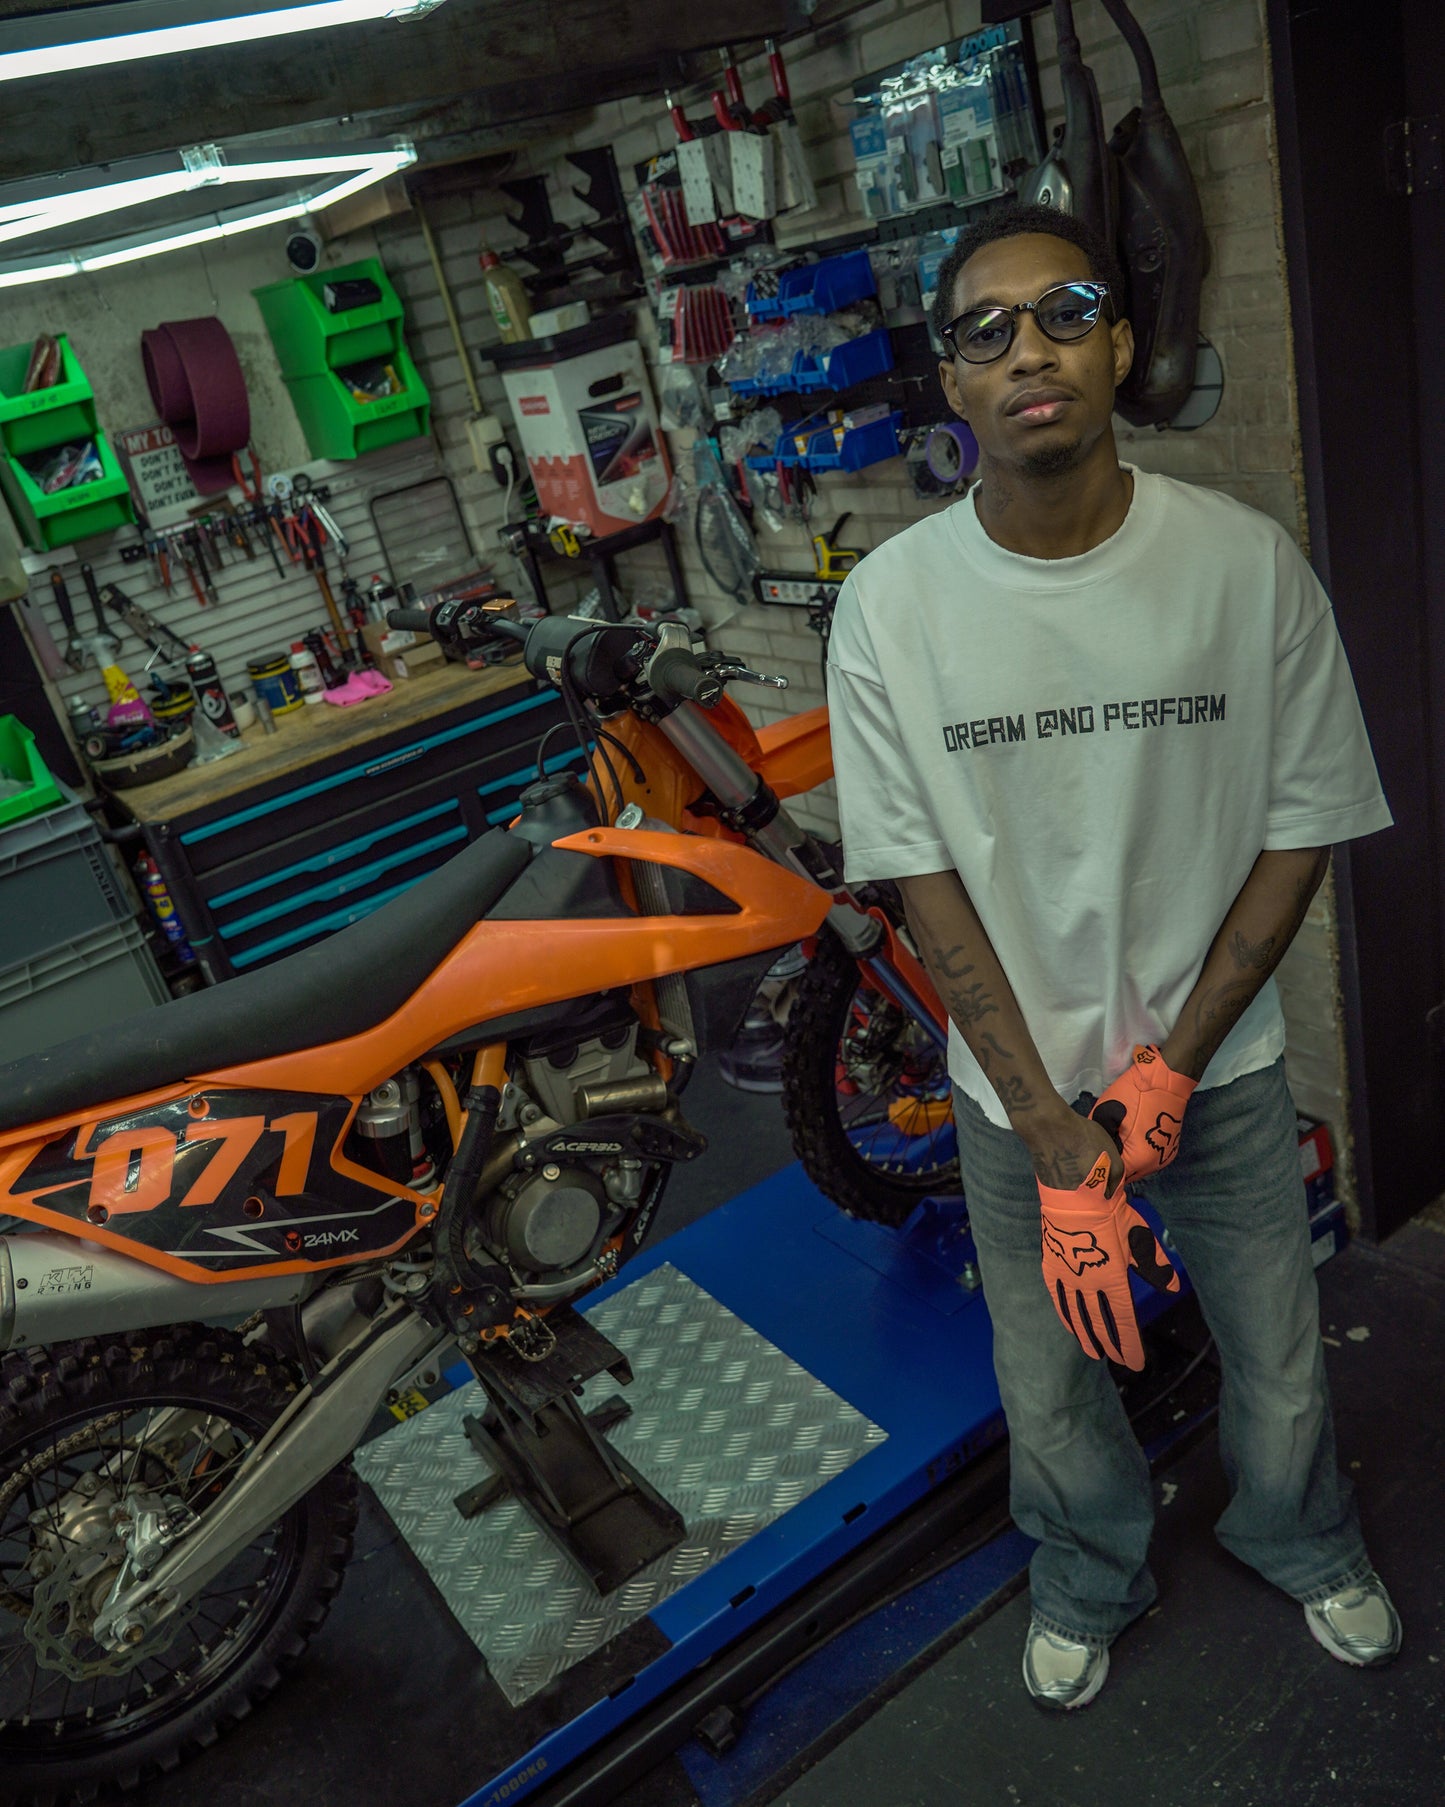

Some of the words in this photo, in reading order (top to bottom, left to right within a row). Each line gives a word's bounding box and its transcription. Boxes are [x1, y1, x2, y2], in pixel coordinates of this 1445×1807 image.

[127, 433, 149, 453] MY
[943, 714, 1026, 752] DREAM
[1103, 694, 1226, 731] PERFORM
[88, 1111, 318, 1214] 071
[303, 1228, 360, 1248] 24MX
[40, 1266, 94, 1288] KTM
